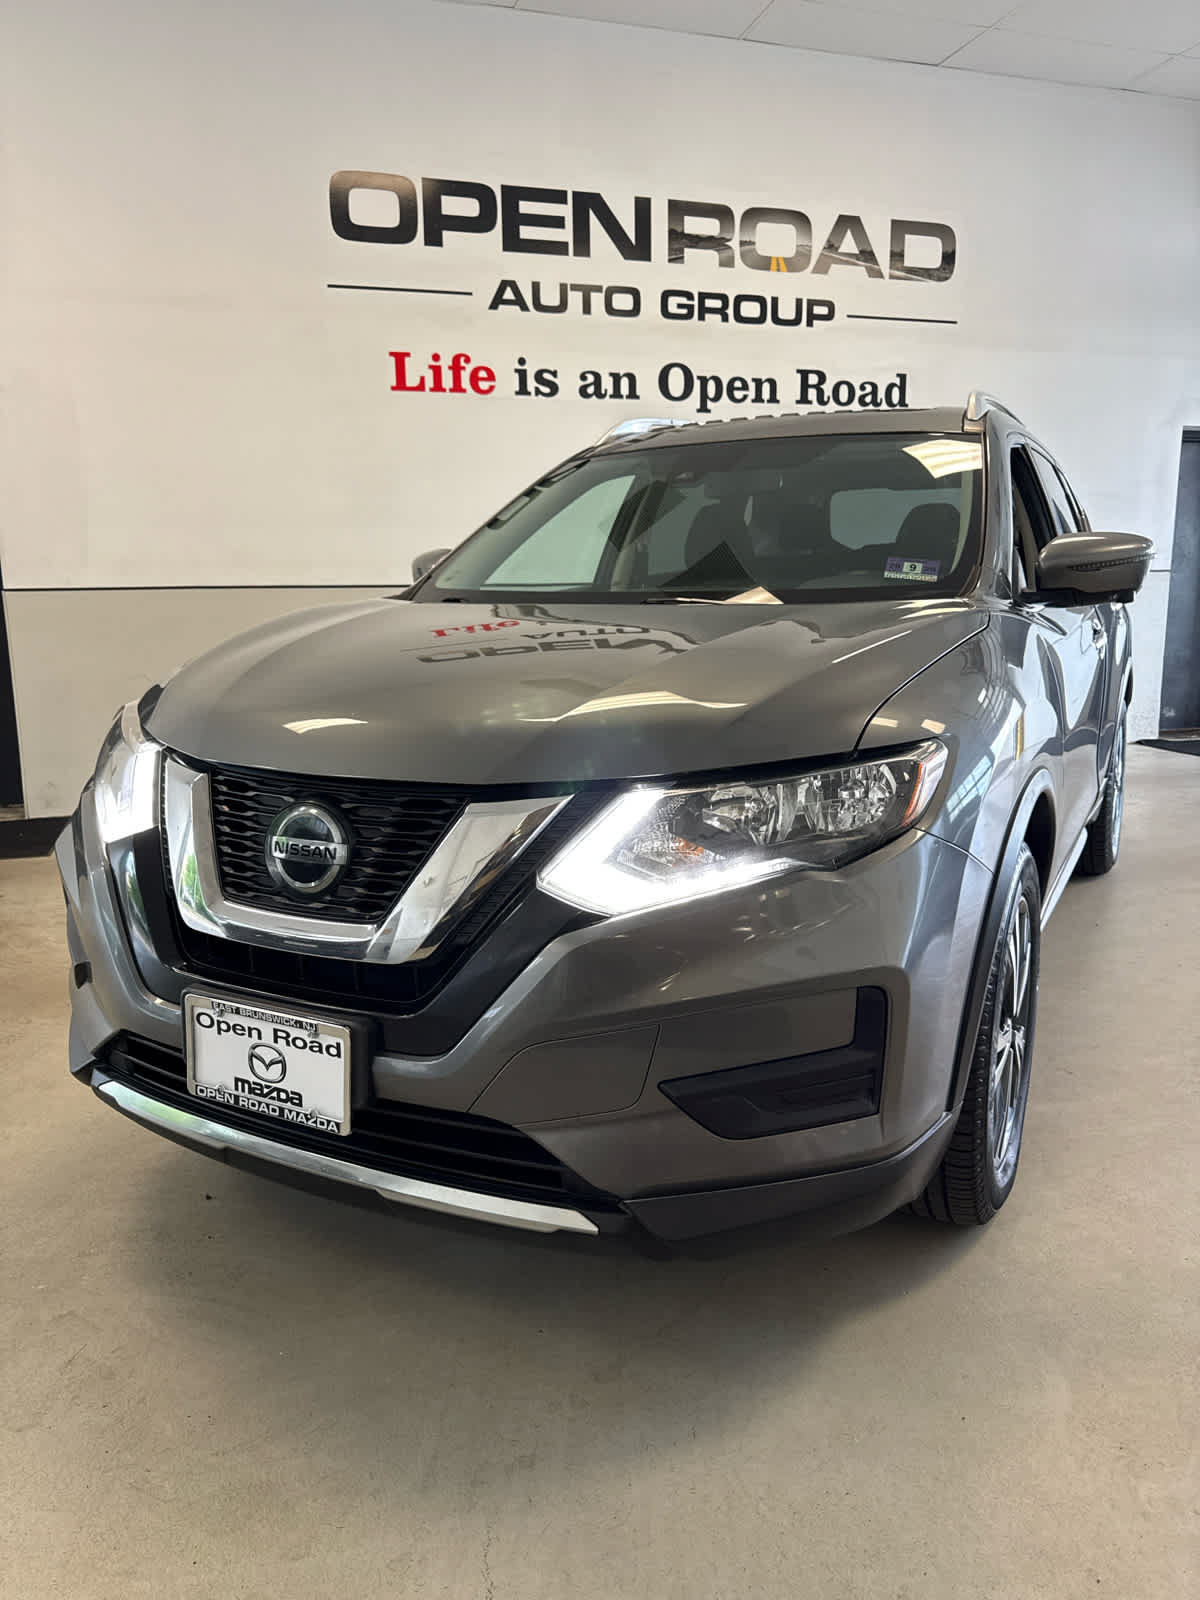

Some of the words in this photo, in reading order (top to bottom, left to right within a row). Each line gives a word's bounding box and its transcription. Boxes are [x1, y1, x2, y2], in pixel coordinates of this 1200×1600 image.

[329, 170, 652, 262] OPEN
[668, 199, 956, 283] ROAD
[488, 279, 641, 317] AUTO
[660, 289, 835, 327] GROUP
[389, 351, 496, 395] Life
[514, 357, 560, 398] is
[578, 370, 640, 400] an
[658, 362, 780, 413] Open
[795, 369, 909, 408] Road
[909, 563, 918, 572] 9
[274, 841, 337, 860] NISSAN
[195, 1011, 262, 1041] Open
[273, 1028, 342, 1058] Road
[213, 1001, 237, 1015] EAST
[302, 1021, 317, 1032] NJ
[196, 1085, 234, 1105] OPEN
[239, 1097, 280, 1116] ROAD
[284, 1109, 339, 1133] MAZDA
